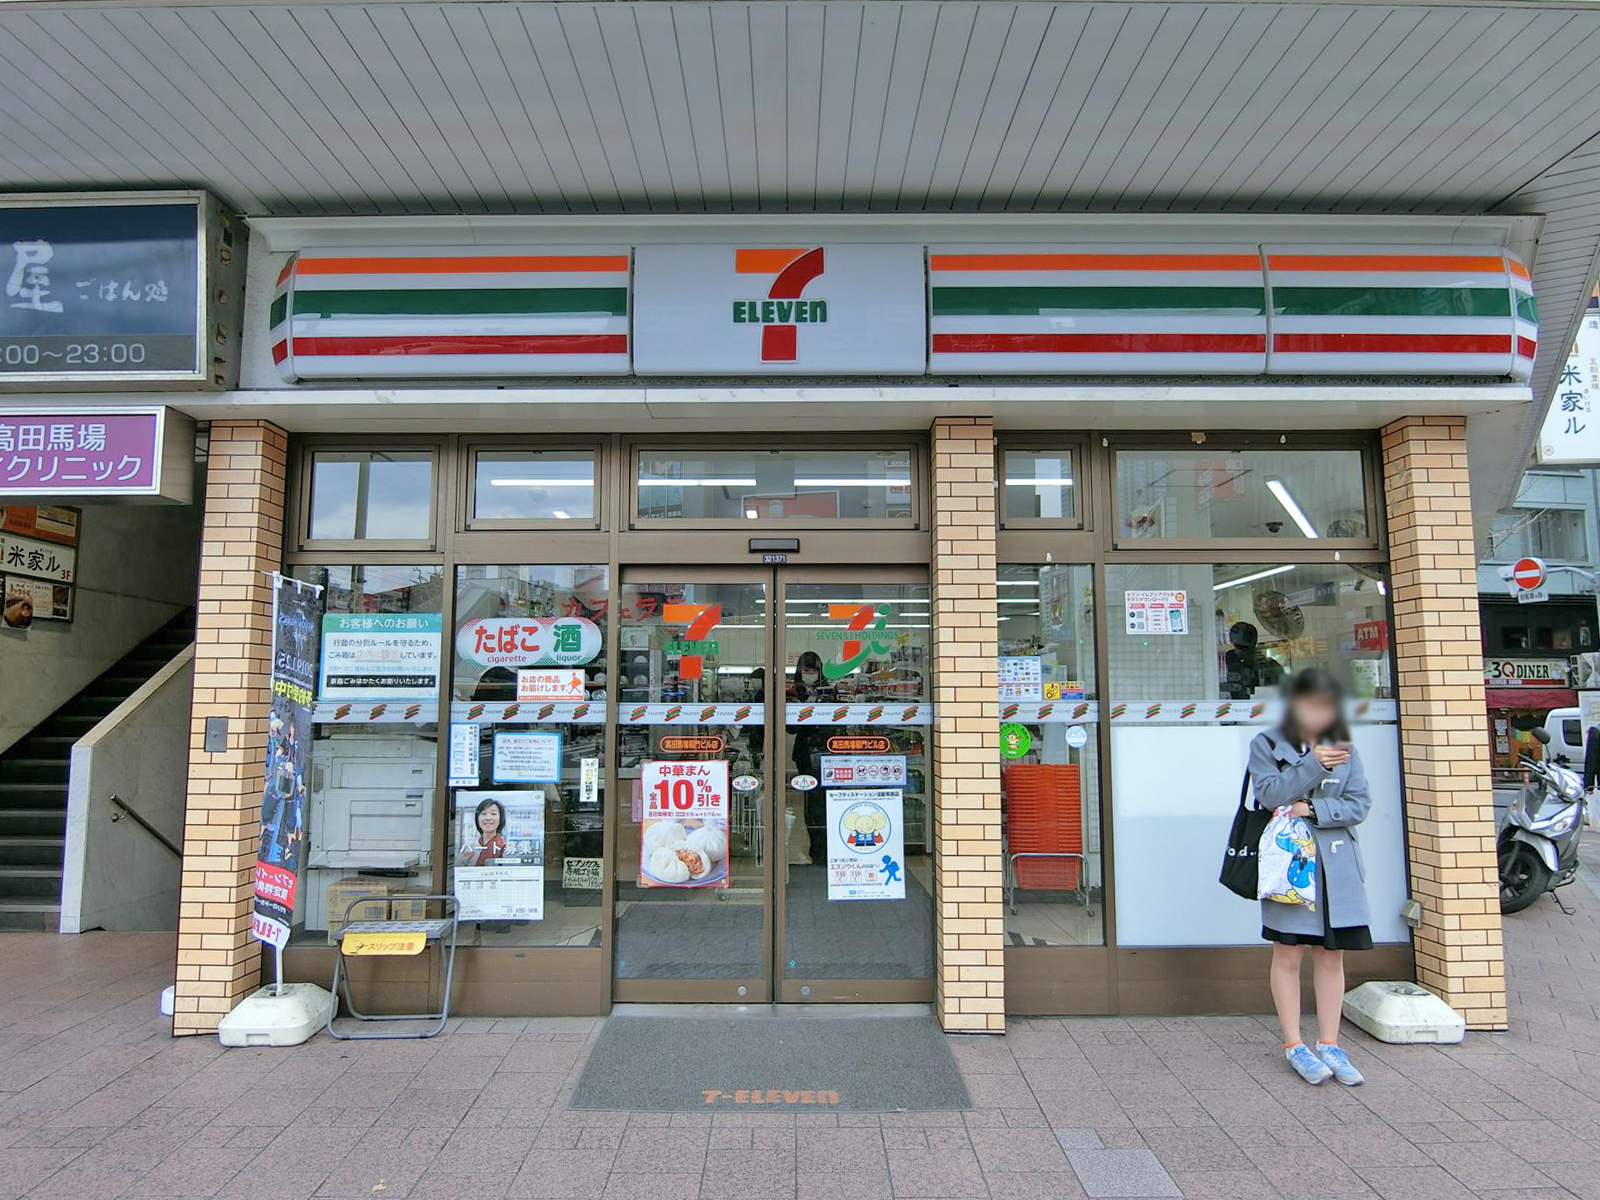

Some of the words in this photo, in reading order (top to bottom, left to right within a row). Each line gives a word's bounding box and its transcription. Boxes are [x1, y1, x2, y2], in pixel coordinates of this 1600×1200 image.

[1559, 364, 1587, 435] 米家ル
[0, 455, 142, 481] クリニック
[7, 545, 61, 572] 米家ル
[340, 619, 429, 629] お客様へのお願い
[475, 624, 540, 653] たばこ
[553, 624, 581, 652] 酒
[1357, 626, 1379, 640] ATM
[487, 654, 527, 663] cigarette
[556, 653, 582, 662] liquor
[1516, 665, 1550, 678] DINER
[660, 765, 710, 777] 中華まん
[697, 794, 721, 807] 引き
